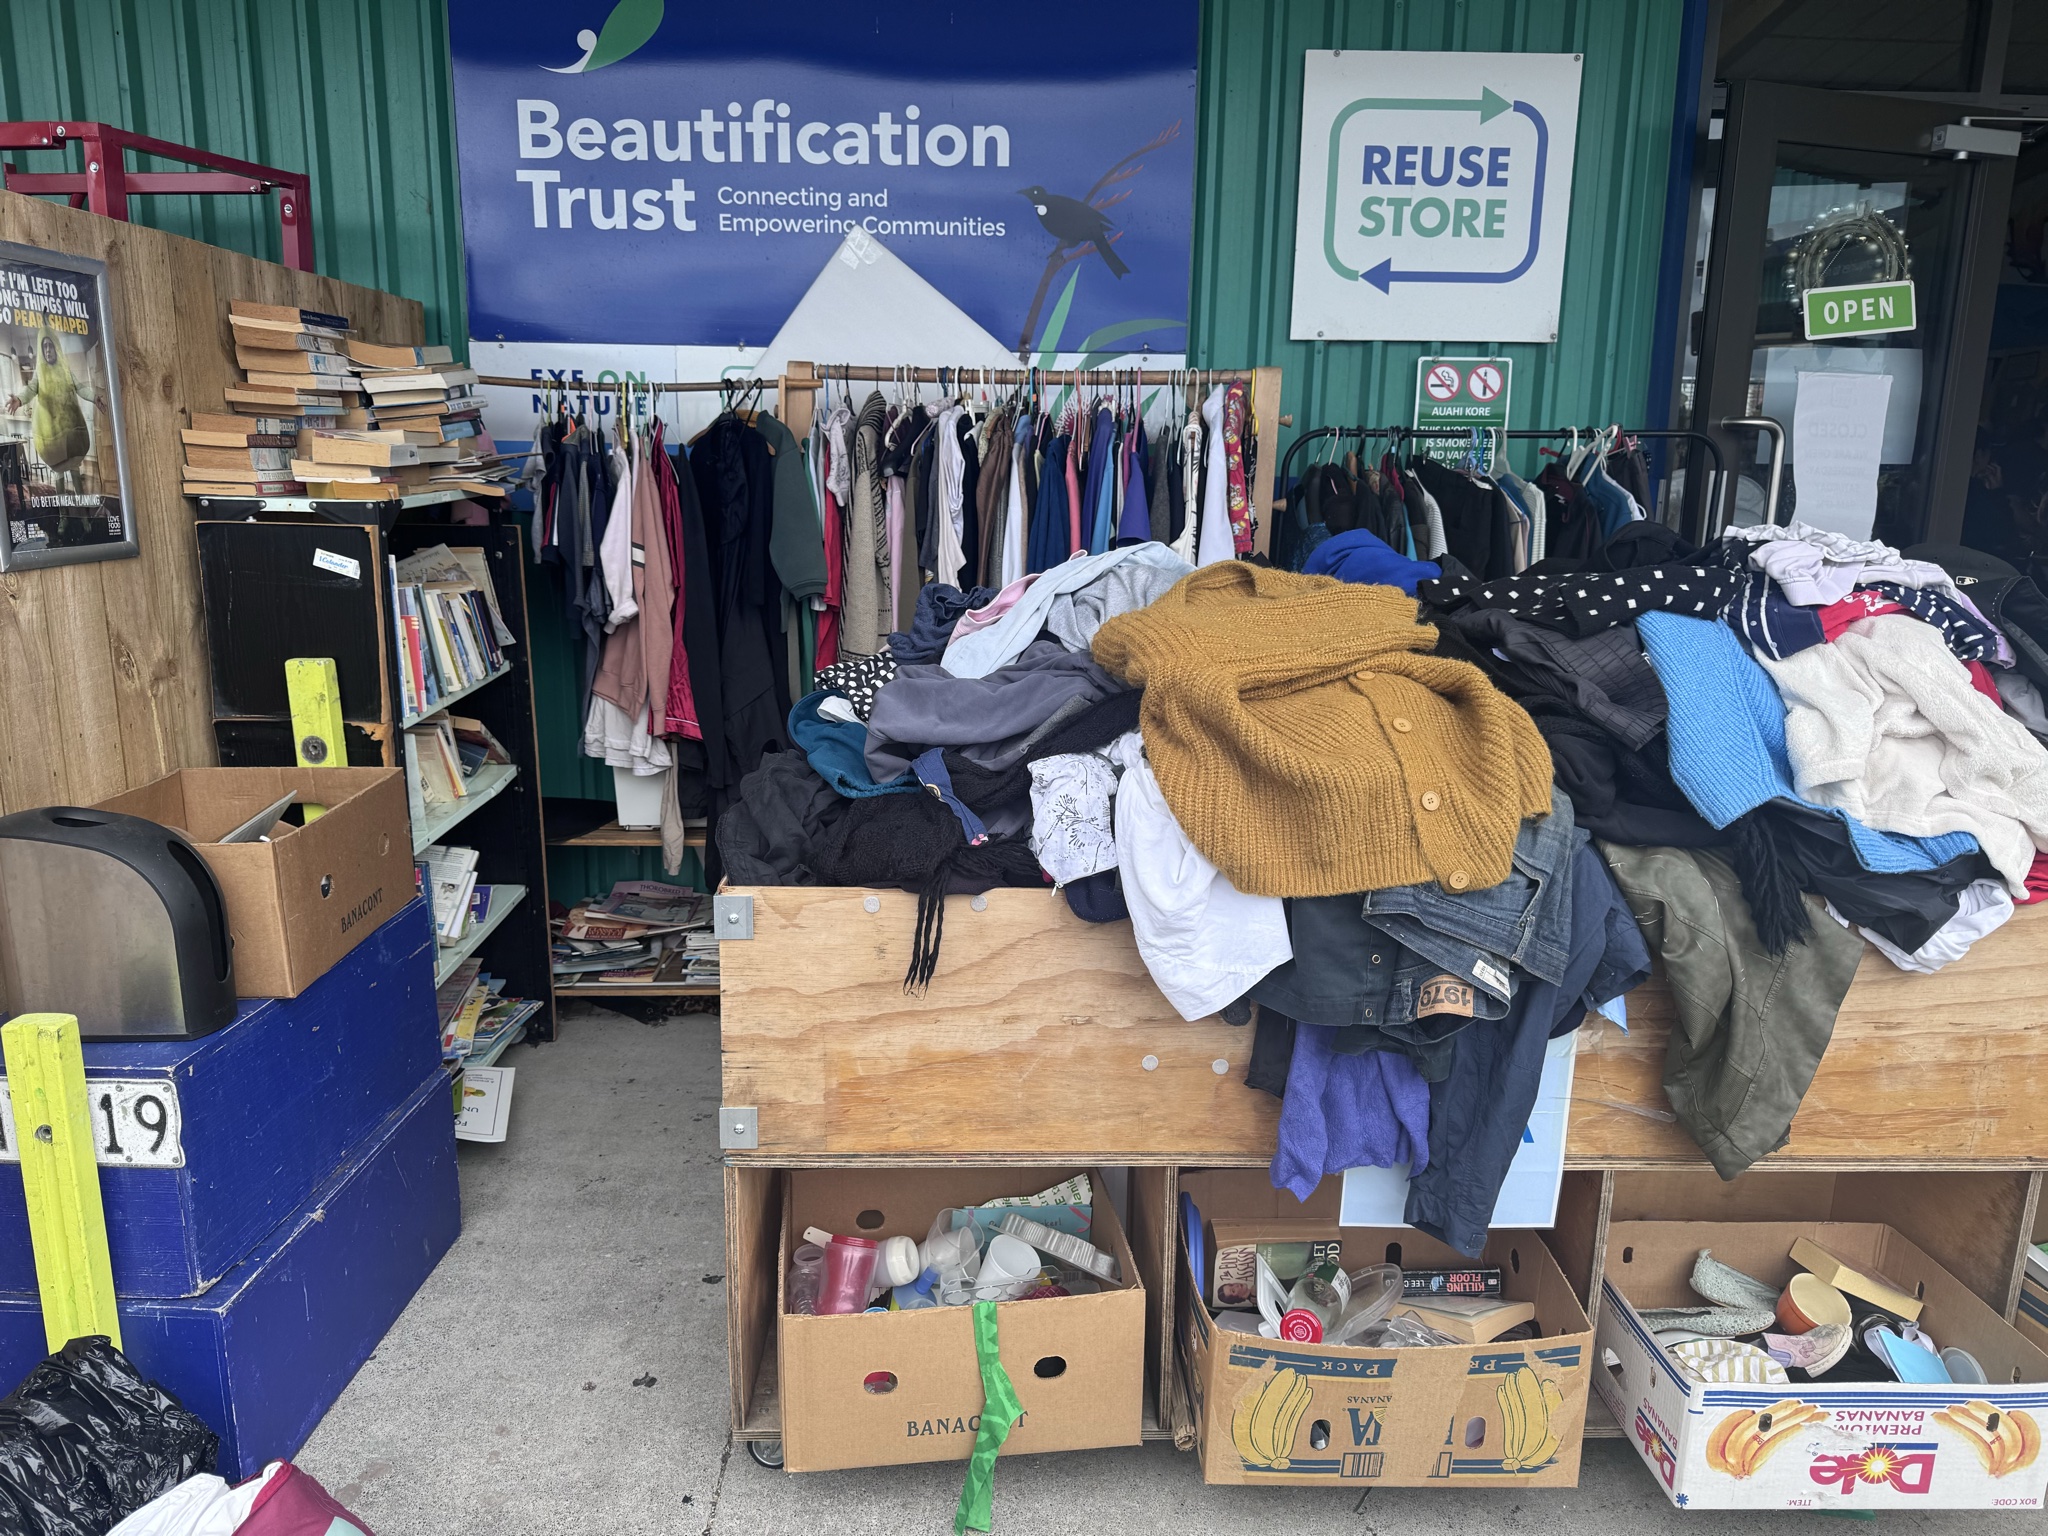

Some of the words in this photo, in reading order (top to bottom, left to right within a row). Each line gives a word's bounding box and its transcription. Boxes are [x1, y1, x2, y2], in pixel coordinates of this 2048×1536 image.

[515, 98, 1011, 168] Beautification
[1362, 144, 1511, 188] REUSE
[515, 169, 698, 232] Trust
[717, 186, 842, 211] Connecting
[847, 188, 888, 208] and
[719, 213, 856, 237] Empowering
[862, 216, 1006, 237] Communities
[1357, 195, 1508, 238] STORE
[0, 270, 6, 288] F
[8, 271, 30, 292] I'M
[31, 275, 54, 296] LEFT
[55, 281, 78, 301] TOO
[22, 292, 63, 315] THINGS
[64, 300, 89, 319] WILL
[1823, 296, 1895, 325] OPEN
[13, 308, 44, 329] PEAR
[48, 314, 88, 336] SHAPED
[1431, 406, 1463, 416] AUAHI
[1465, 406, 1491, 416] KORE
[1425, 438, 1435, 447] IS
[41, 495, 60, 508] BETTER
[341, 887, 384, 934] BANACONT
[1420, 985, 1471, 1008] 1970
[1411, 1279, 1425, 1287] LEE
[1446, 1281, 1485, 1293] KILLING
[1449, 1273, 1481, 1283] FLOOR
[1320, 1360, 1380, 1375] PACK
[1346, 1395, 1392, 1404] ANANAS
[906, 1410, 1029, 1437] BANACT
[1643, 1397, 1678, 1450] BANANAS
[1835, 1410, 1925, 1422] BANANAS
[1634, 1414, 1676, 1490] Dole
[1808, 1447, 1936, 1495] Dole
[1786, 1499, 1812, 1507] ITEM:
[1991, 1497, 2018, 1506] CODE:
[2019, 1498, 2038, 1506] BOX
